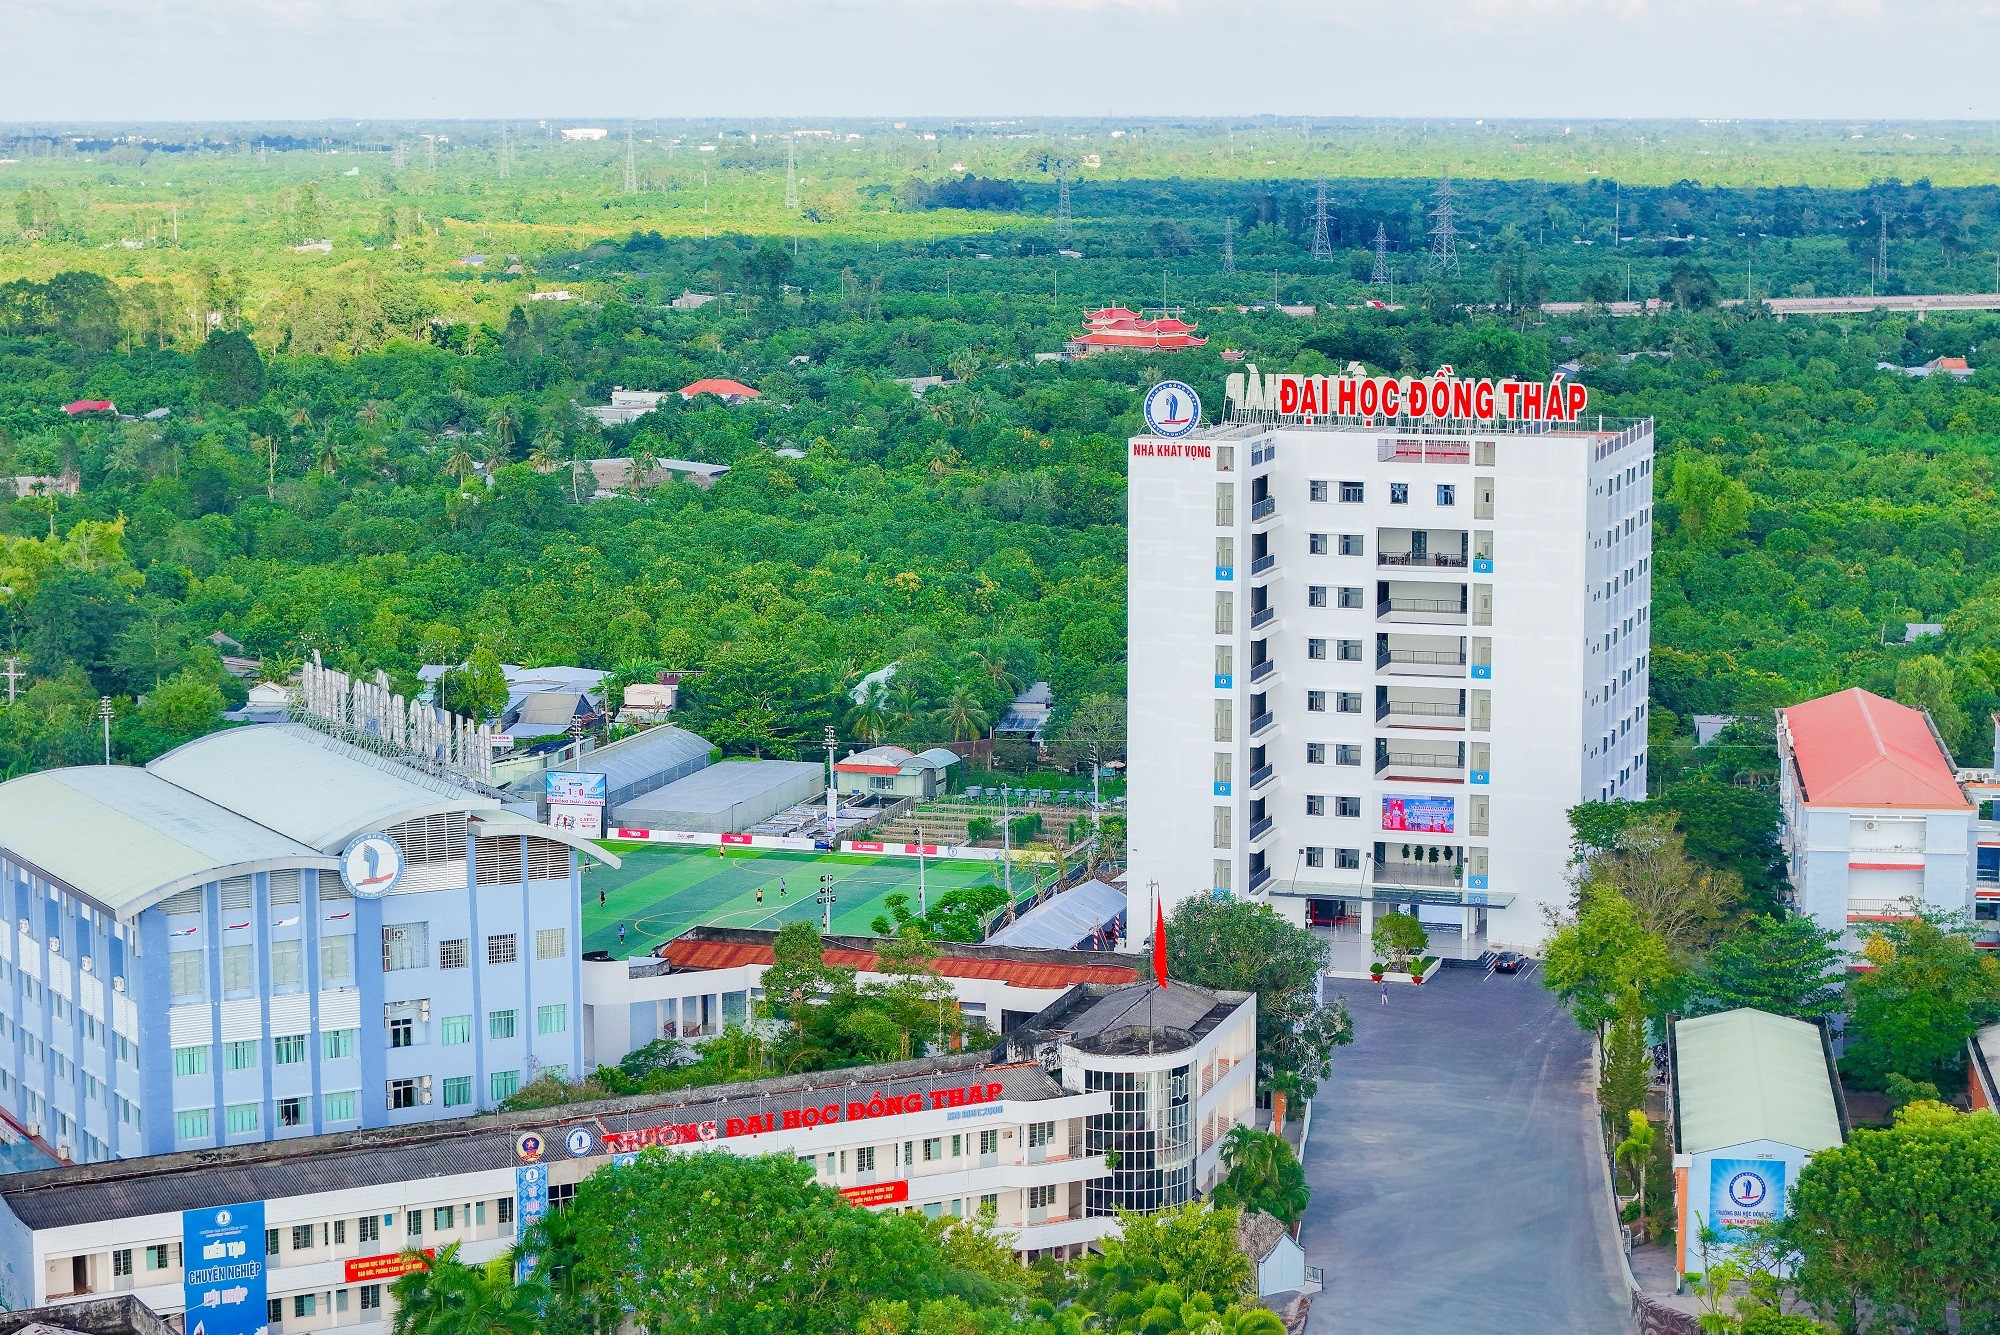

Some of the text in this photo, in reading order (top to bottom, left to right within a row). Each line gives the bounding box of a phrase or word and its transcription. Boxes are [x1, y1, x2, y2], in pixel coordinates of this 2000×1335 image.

[1279, 364, 1588, 428] ĐẠI HỌC ĐỒNG THÁP
[1133, 441, 1211, 460] NHÀ KHÁT VỌNG
[725, 1113, 774, 1139] ĐẠI
[782, 1104, 840, 1131] HỌC
[847, 1090, 923, 1121] ĐỒNG
[929, 1080, 1004, 1110] THÁP
[189, 1260, 262, 1285] CHUYÊN NGHIỆP
